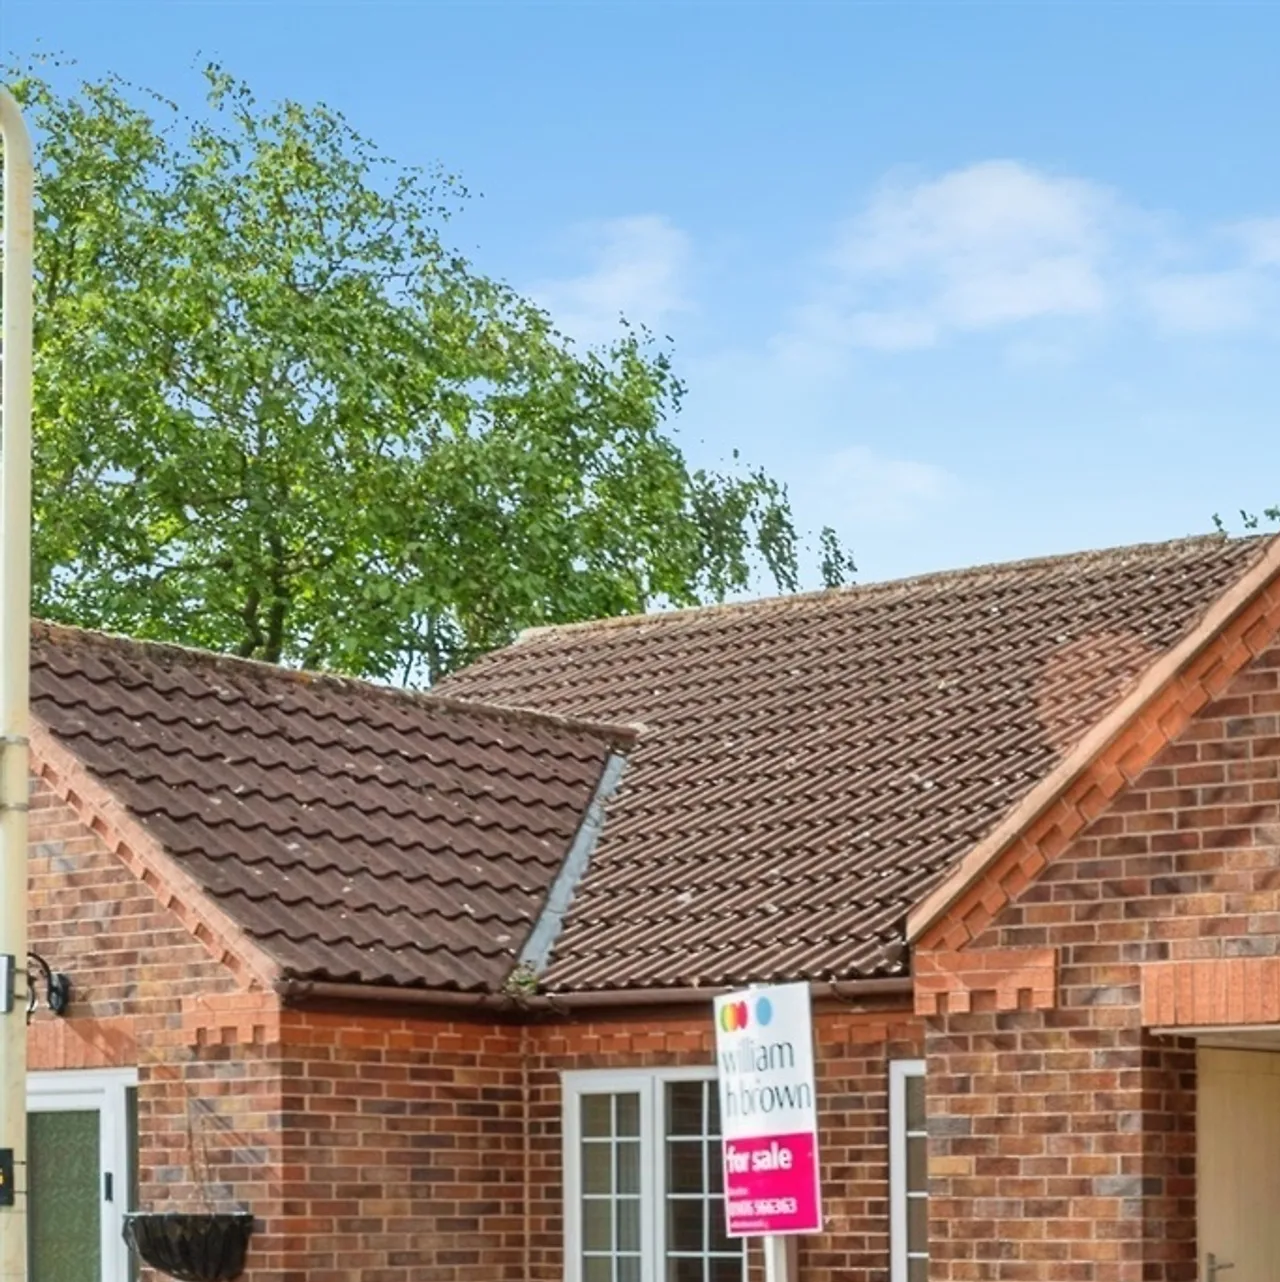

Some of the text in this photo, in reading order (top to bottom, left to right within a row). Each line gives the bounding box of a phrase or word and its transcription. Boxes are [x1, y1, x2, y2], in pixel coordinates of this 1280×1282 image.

[740, 1079, 812, 1116] brown
[728, 1140, 793, 1174] for sale
